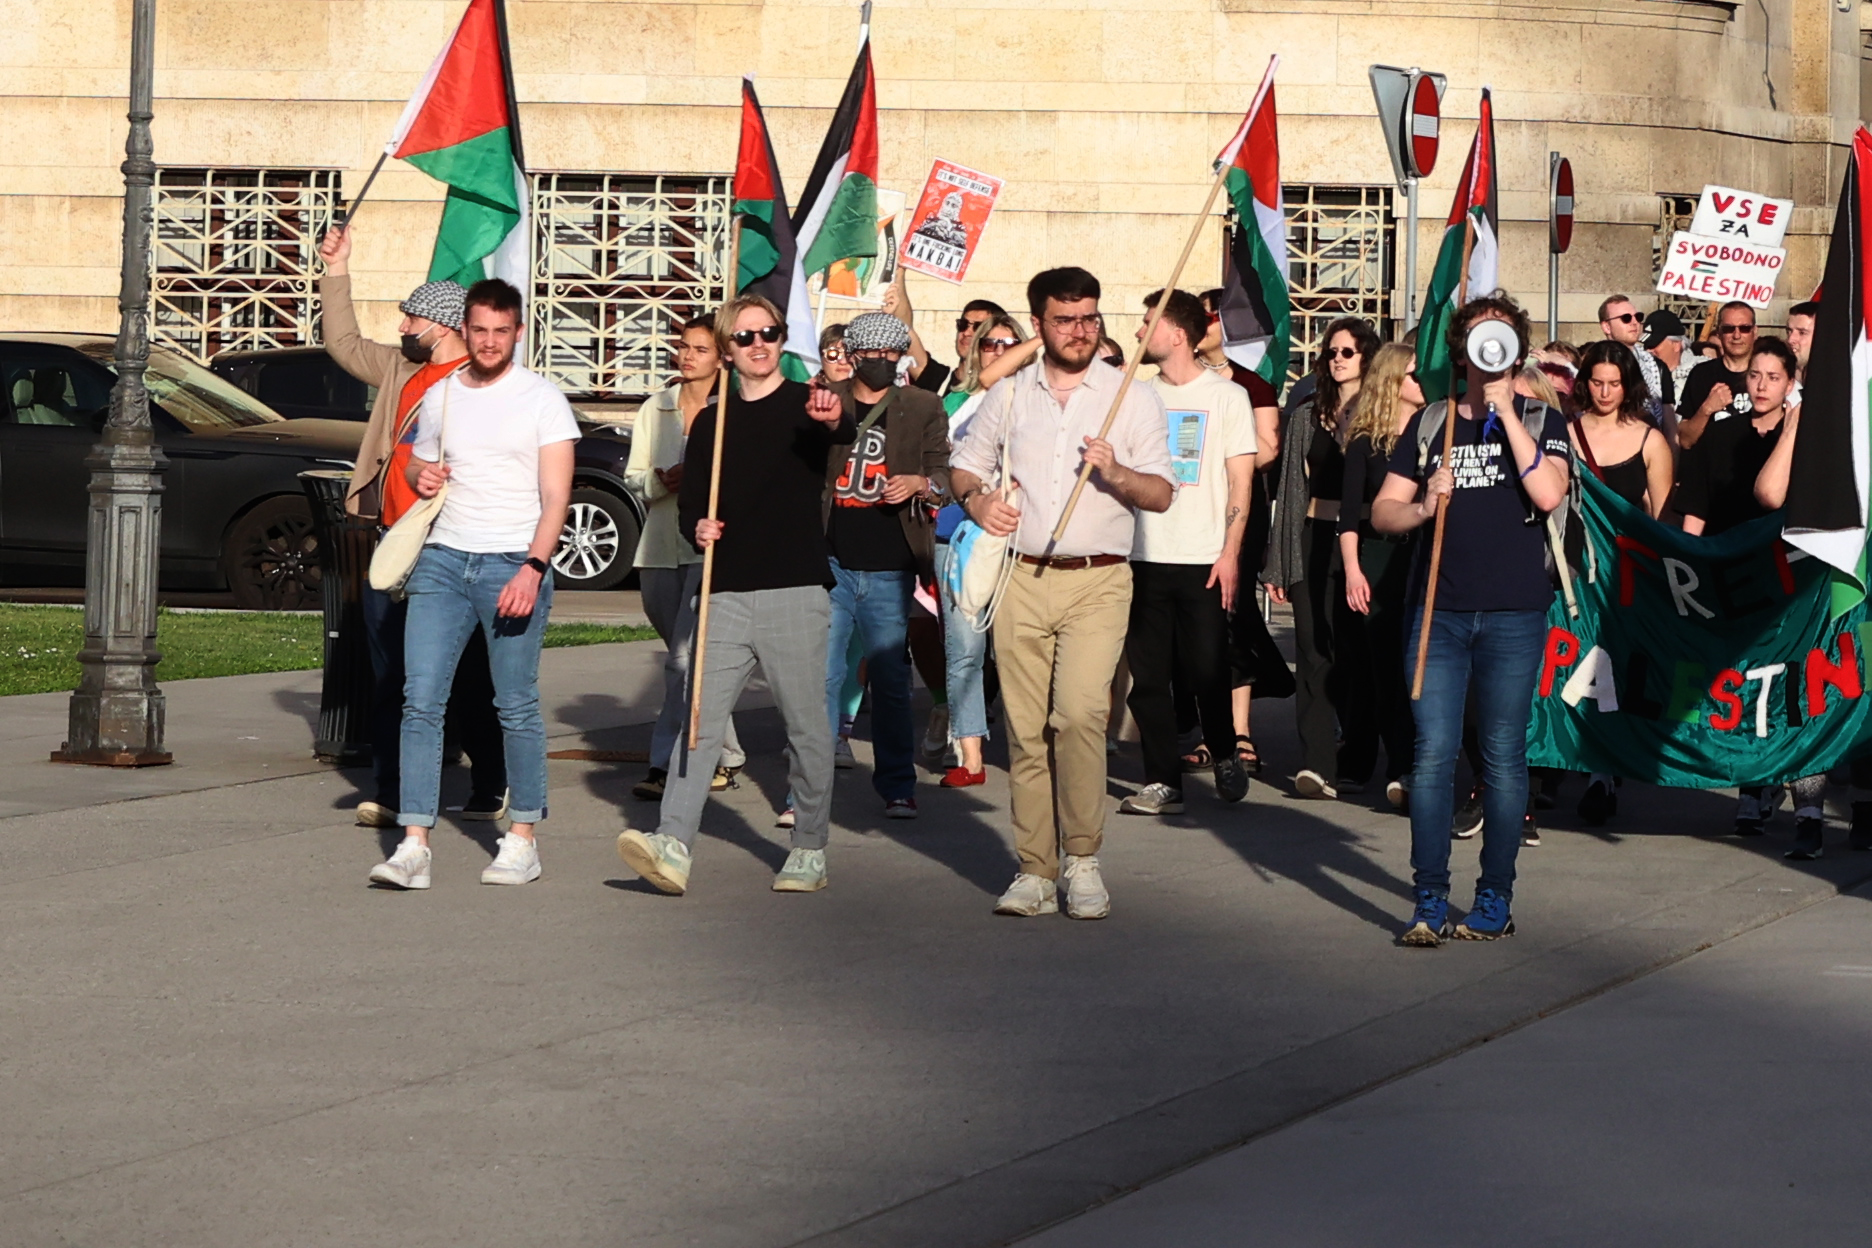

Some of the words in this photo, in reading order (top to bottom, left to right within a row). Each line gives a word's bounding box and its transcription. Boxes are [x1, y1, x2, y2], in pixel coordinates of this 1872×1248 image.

[1711, 191, 1779, 226] VSE
[1719, 219, 1750, 238] ZA
[907, 242, 962, 272] NAKBA!
[1675, 240, 1781, 269] SVOBODNO
[1662, 271, 1774, 303] PALESTINO
[1454, 468, 1483, 477] LIVING
[1485, 465, 1498, 475] ON
